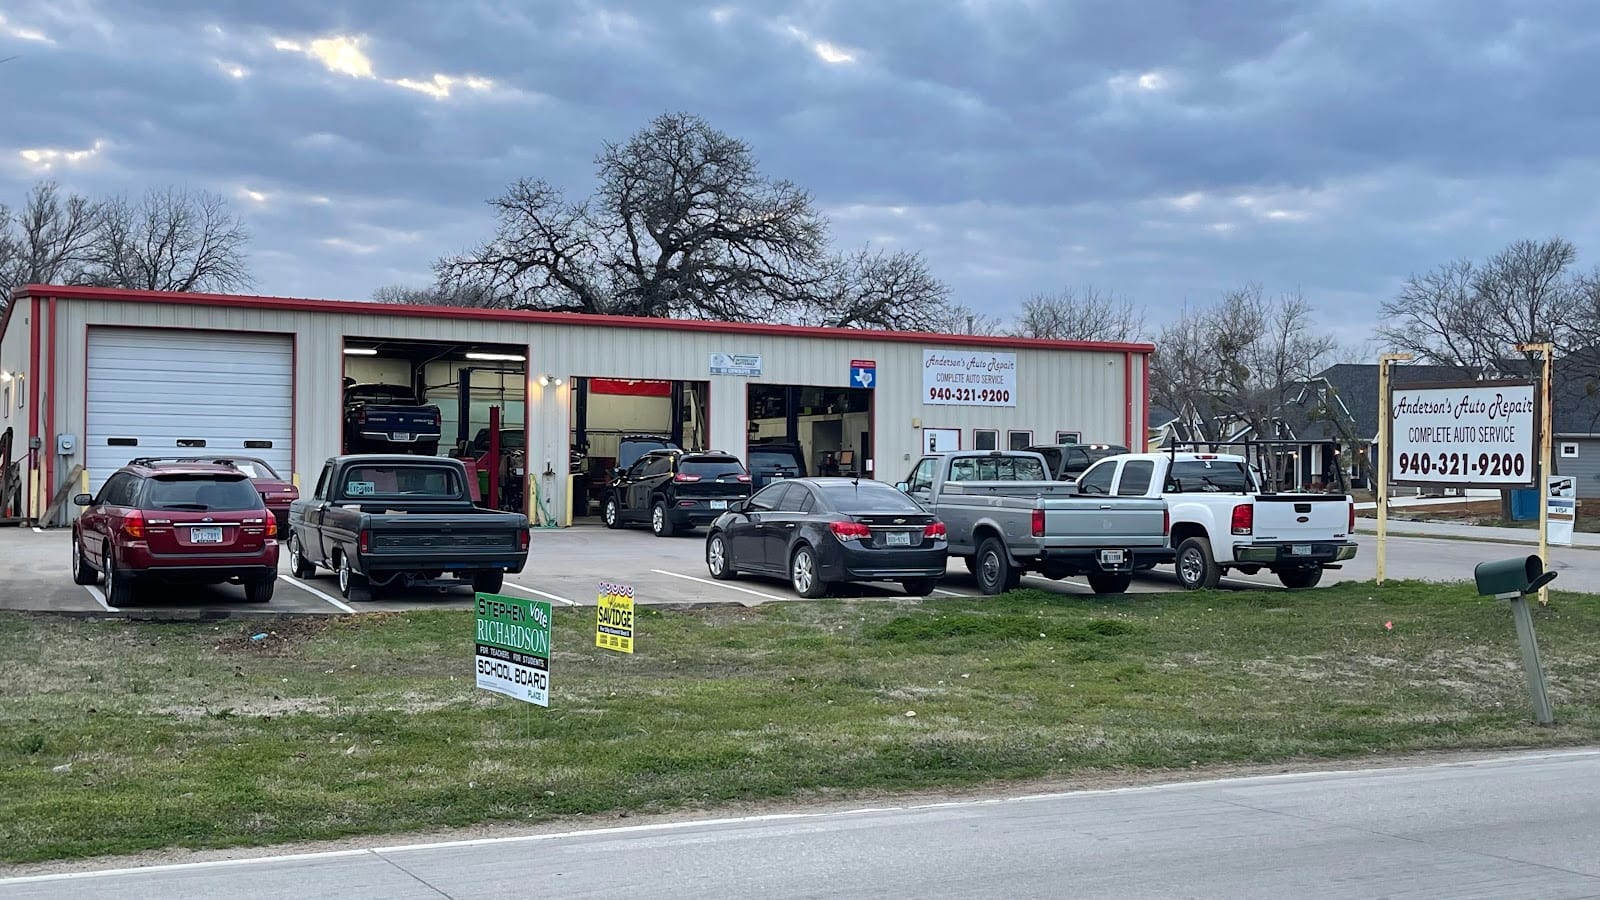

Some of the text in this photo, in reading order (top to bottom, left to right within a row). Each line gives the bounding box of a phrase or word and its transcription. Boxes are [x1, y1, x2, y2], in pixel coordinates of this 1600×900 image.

[925, 354, 1014, 373] Anderson's Auto Repair
[936, 372, 1004, 385] COMPLETE AUTO SERVICE
[930, 387, 1010, 403] 940-321-9200
[1393, 393, 1533, 422] Anderson's Auto Repair
[1408, 426, 1516, 443] COMPLETE AUTO SERVICE
[1399, 452, 1525, 477] 940-321-9200
[478, 598, 548, 629] STEPHEN Vote
[598, 606, 632, 628] SAVIDGE
[477, 618, 549, 654] RICHARDSON
[478, 659, 513, 682] SCHOOL
[514, 667, 547, 690] BOARD
